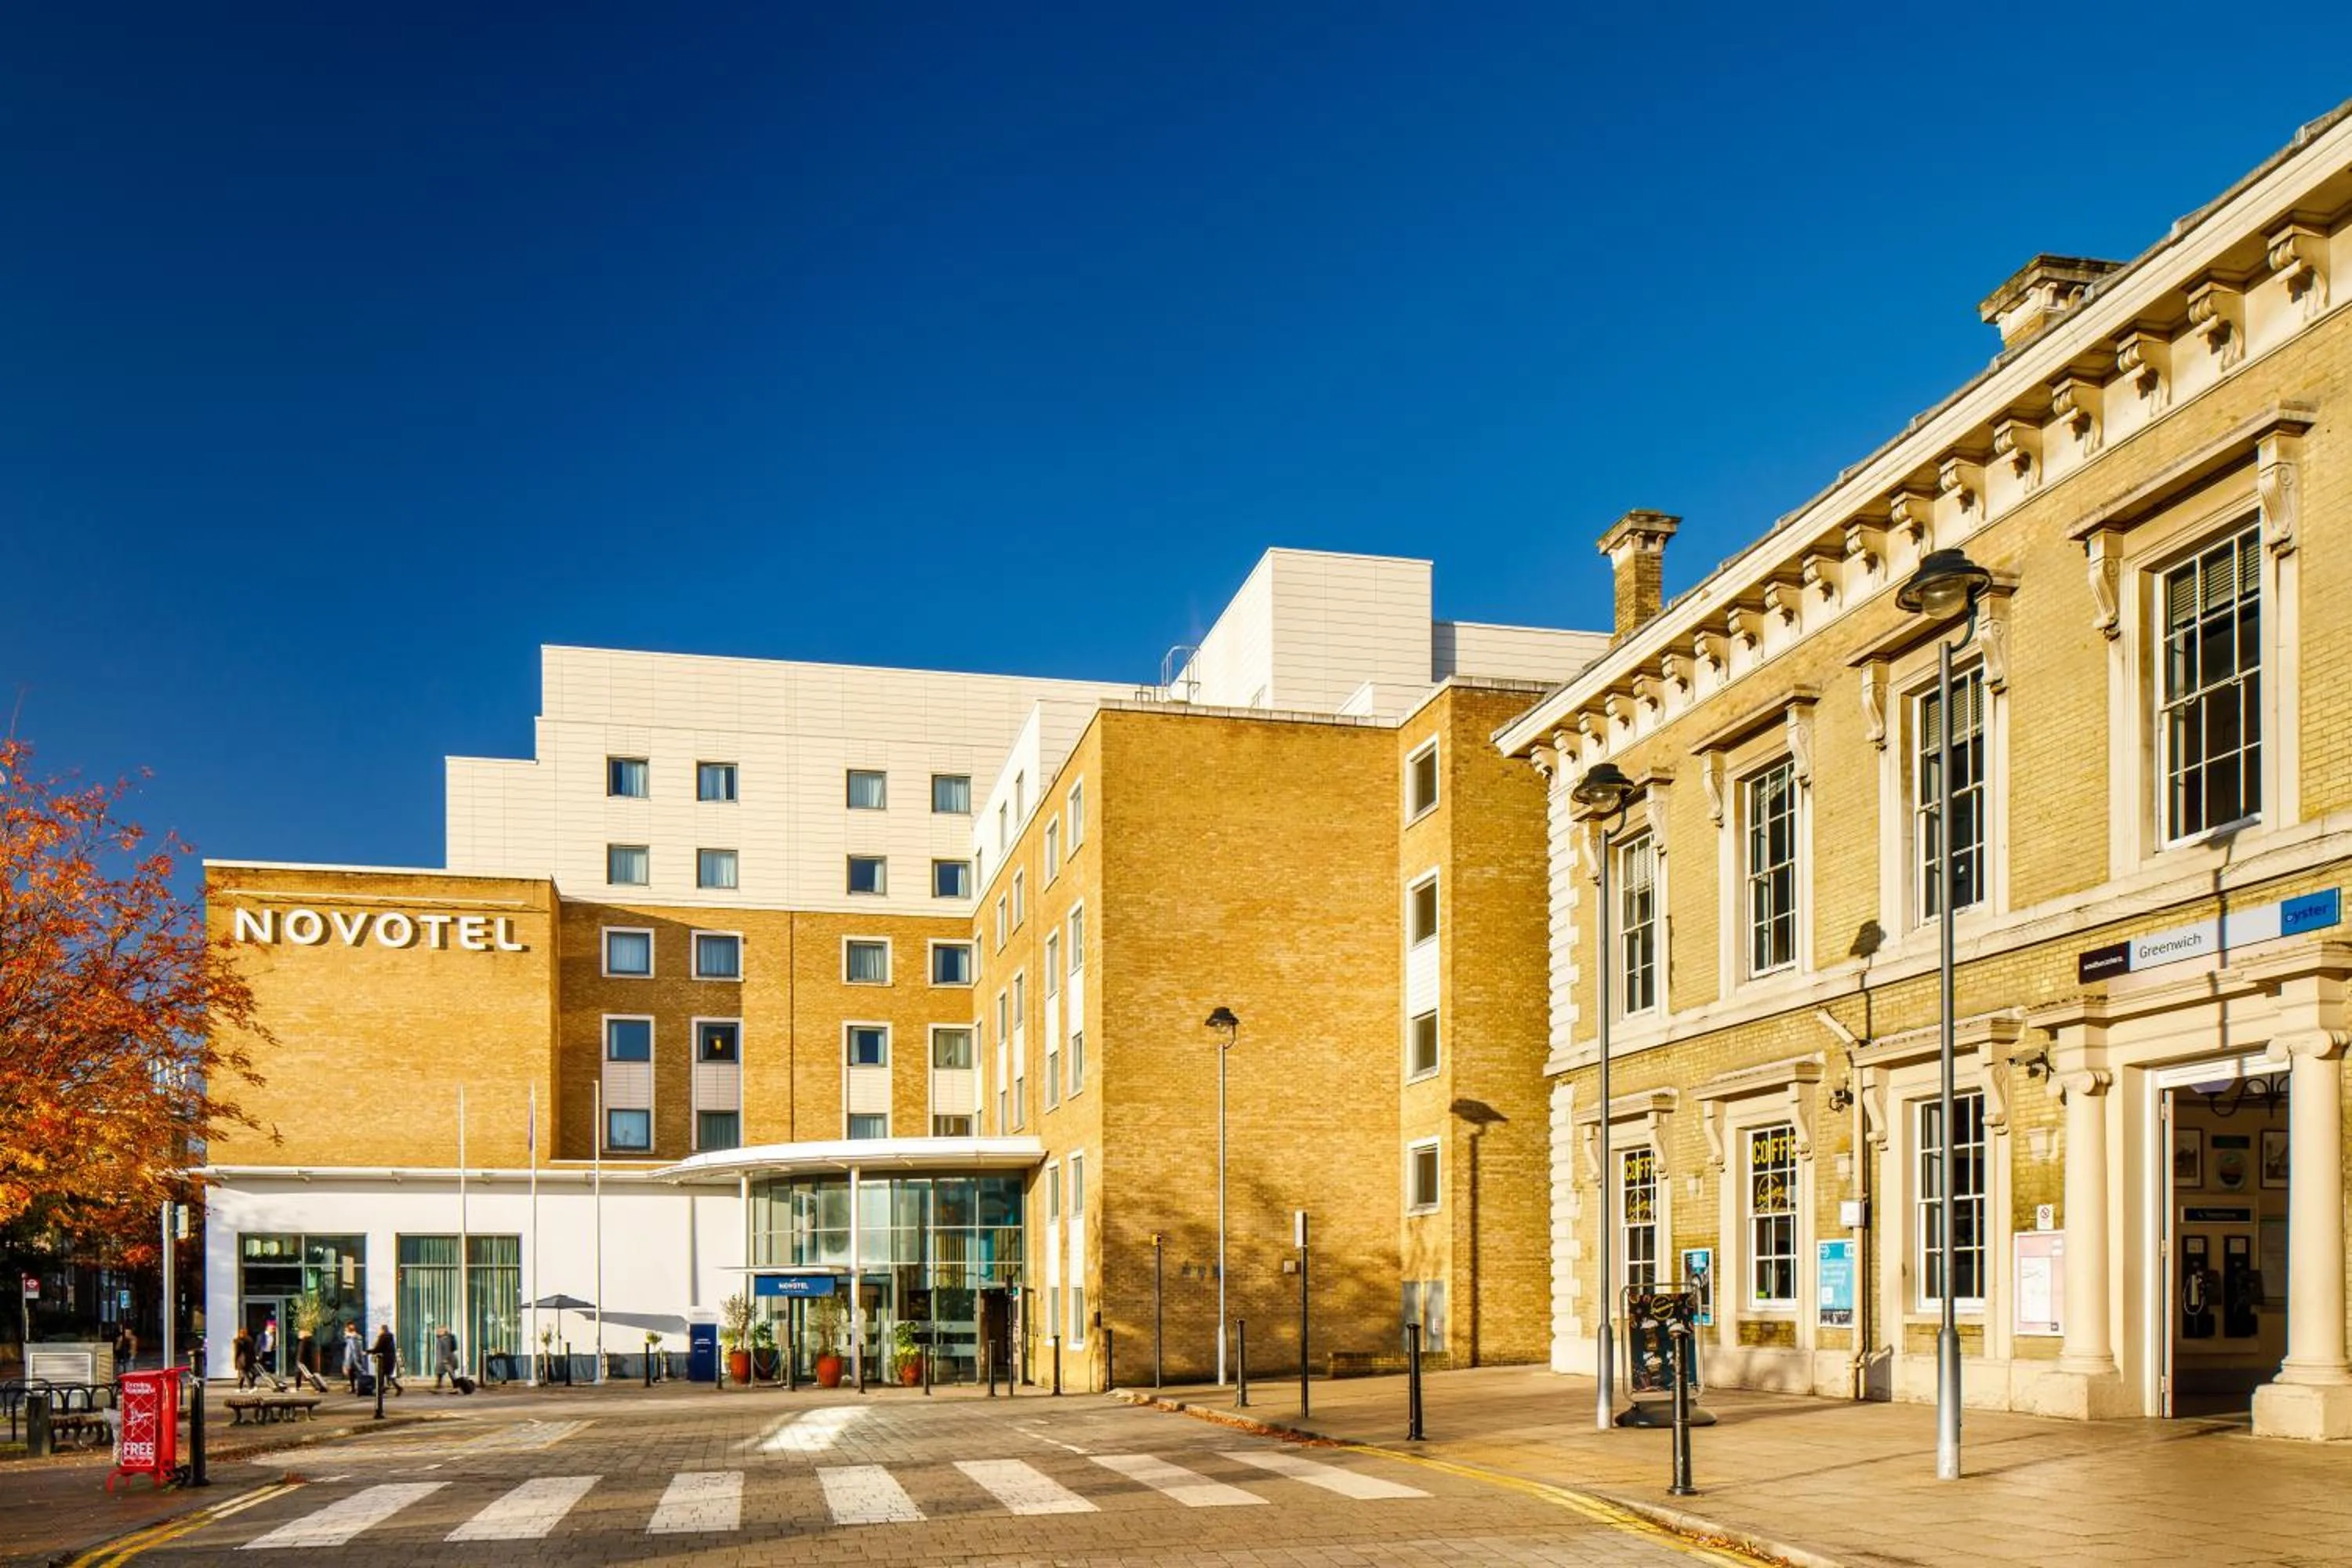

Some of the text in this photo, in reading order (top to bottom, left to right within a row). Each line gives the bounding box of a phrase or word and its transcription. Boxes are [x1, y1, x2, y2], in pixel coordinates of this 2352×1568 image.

[2285, 904, 2328, 924] oyster
[235, 907, 523, 951] NOVOTEL
[2140, 933, 2201, 959] Greenwich
[1753, 1135, 1796, 1164] COFFE
[123, 1442, 154, 1456] FREE
